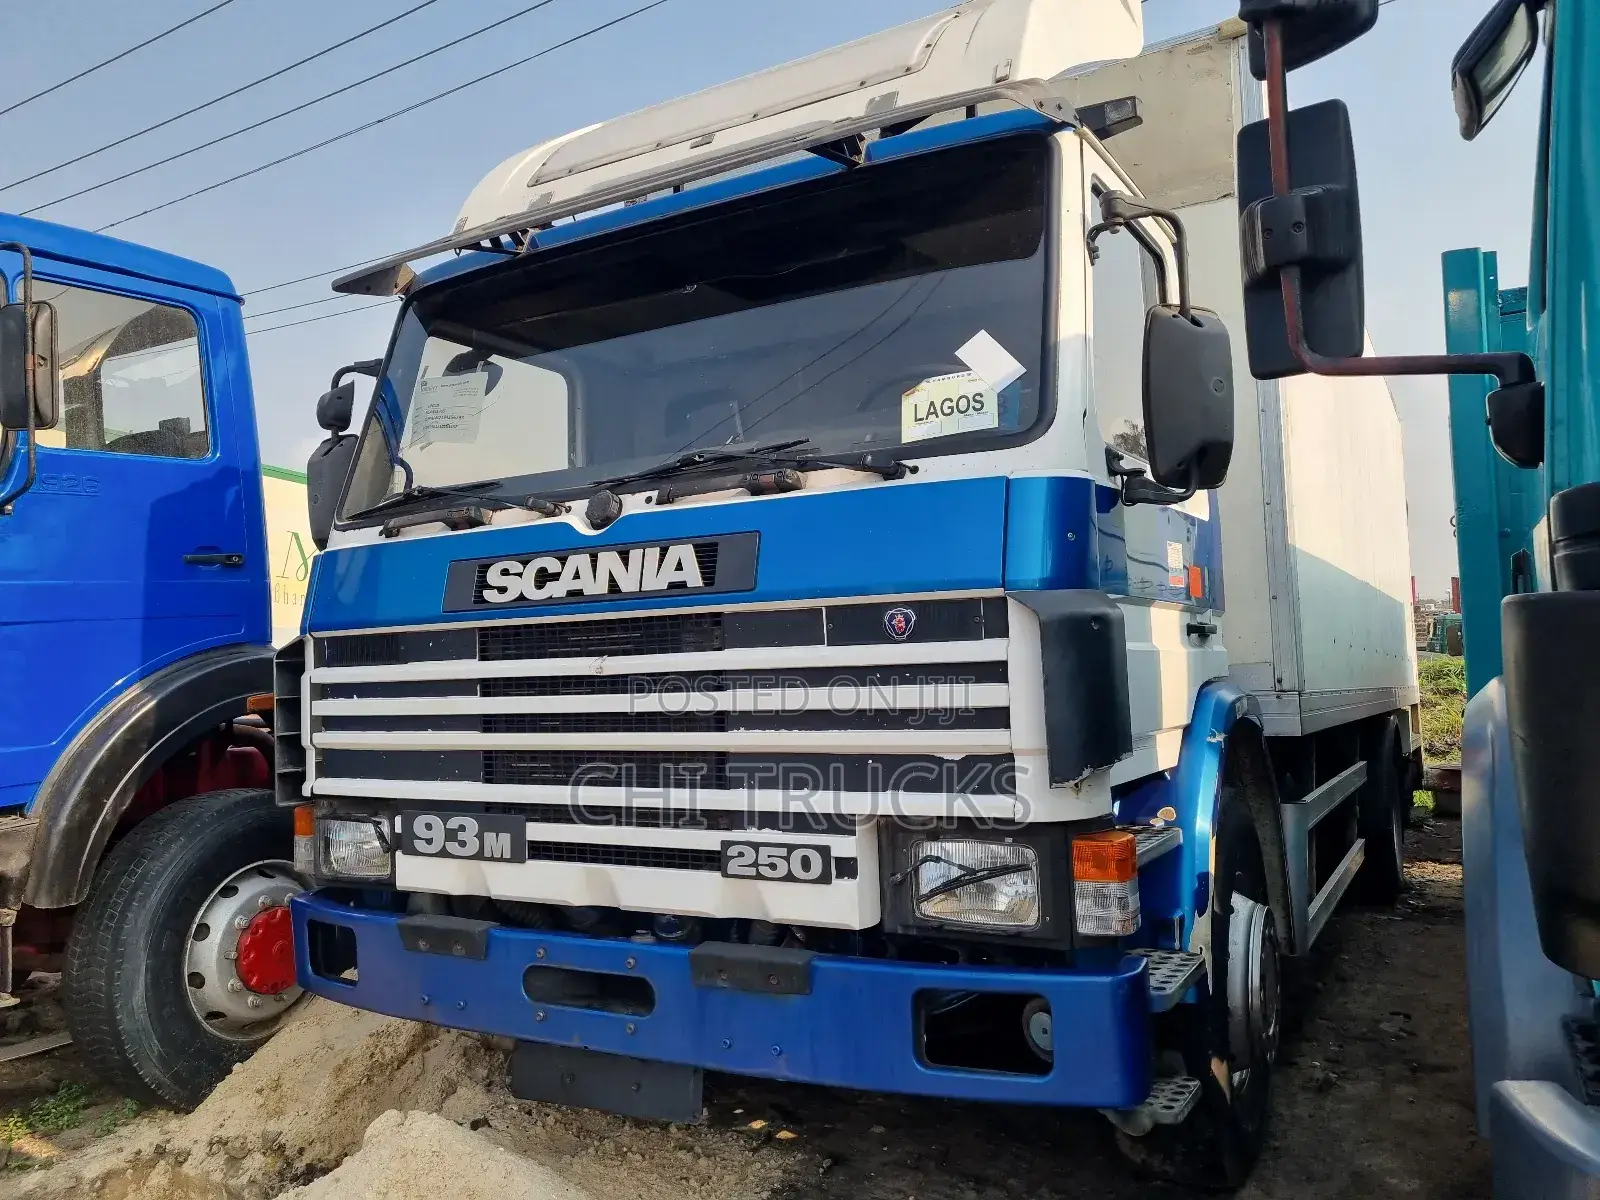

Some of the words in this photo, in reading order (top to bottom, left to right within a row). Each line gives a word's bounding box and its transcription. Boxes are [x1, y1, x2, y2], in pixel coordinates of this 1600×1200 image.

[914, 392, 985, 422] LAGOS
[482, 543, 704, 603] SCANIA
[413, 814, 511, 857] 93M
[726, 844, 823, 880] 250
